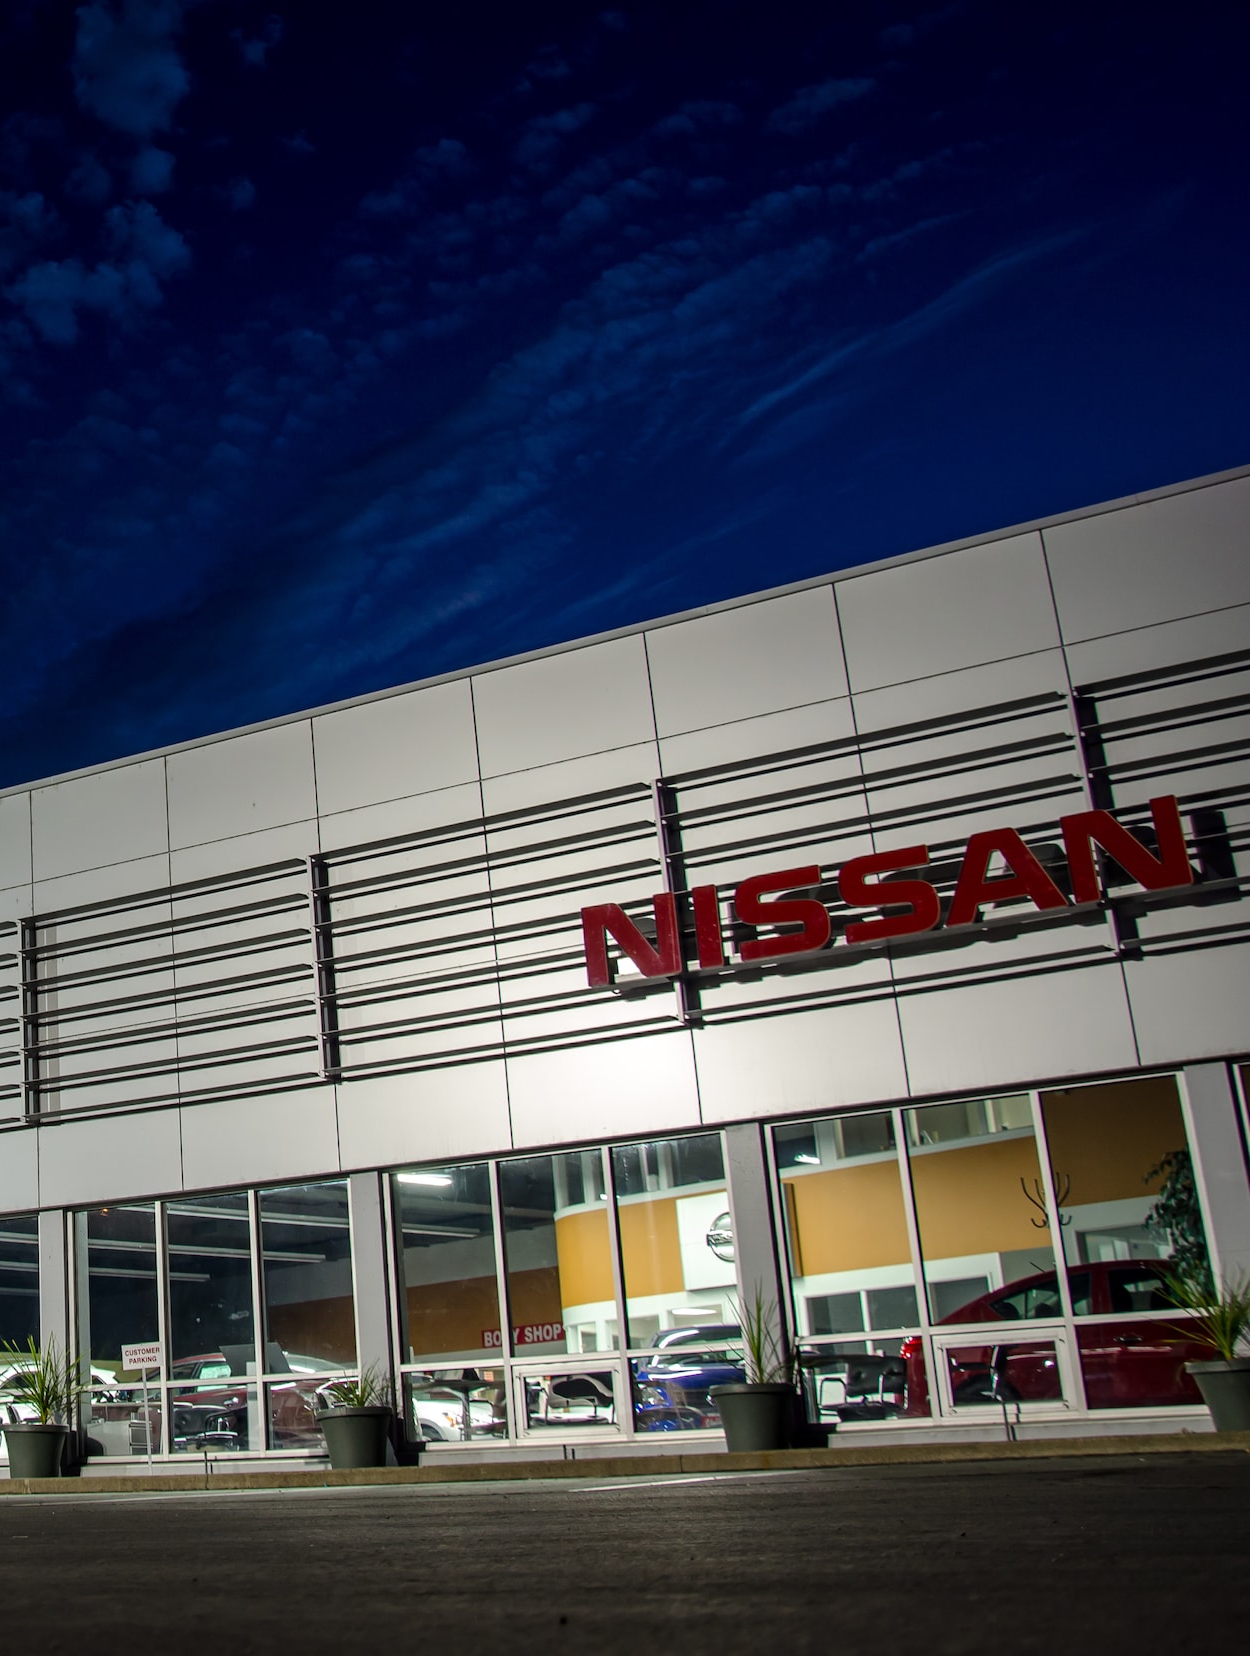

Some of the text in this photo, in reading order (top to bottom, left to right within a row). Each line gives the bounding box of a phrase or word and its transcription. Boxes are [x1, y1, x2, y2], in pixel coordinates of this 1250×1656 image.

[581, 795, 1194, 988] NISSAN
[483, 1323, 562, 1347] BOY SHOP
[125, 1347, 160, 1357] CUSTOMER
[129, 1356, 157, 1364] PARKING
